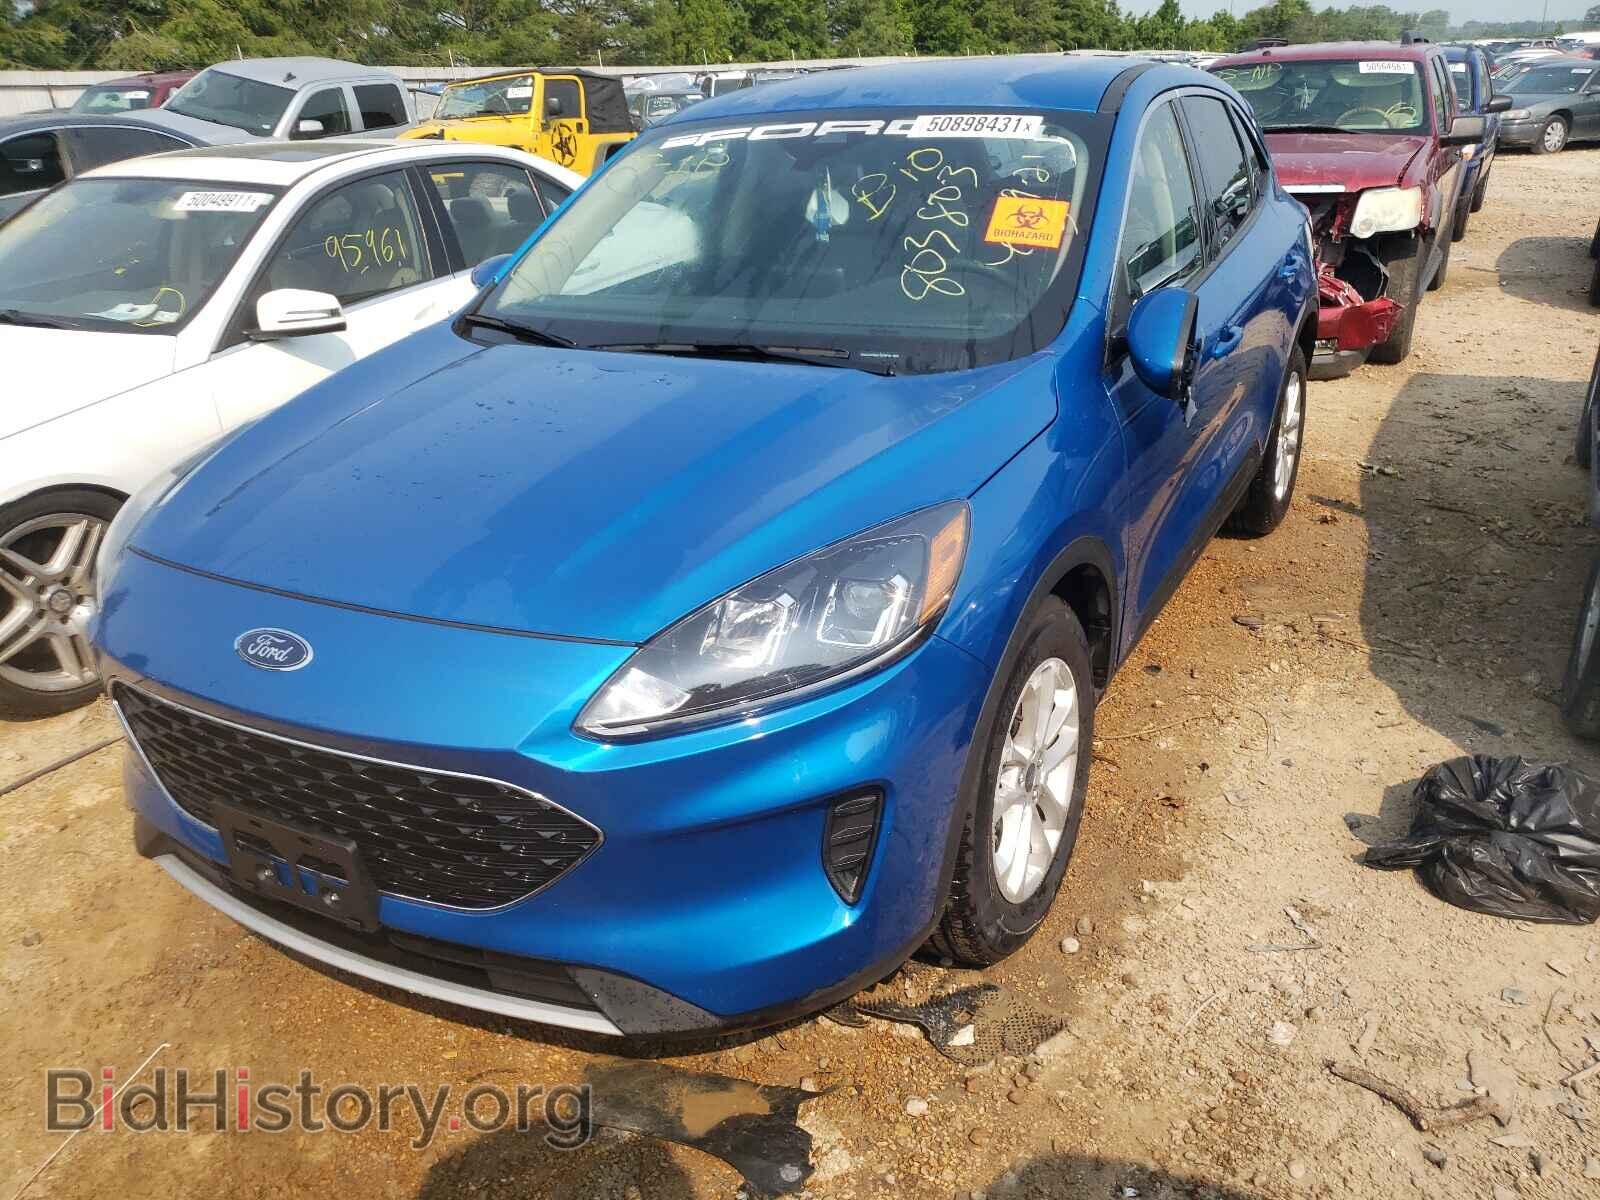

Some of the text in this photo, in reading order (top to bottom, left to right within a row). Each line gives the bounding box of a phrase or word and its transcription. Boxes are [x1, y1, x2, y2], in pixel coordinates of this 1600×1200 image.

[926, 116, 1022, 132] 50898431
[993, 228, 1054, 241] BIOHAZARD
[325, 227, 406, 273] 95961
[247, 634, 294, 662] Ford
